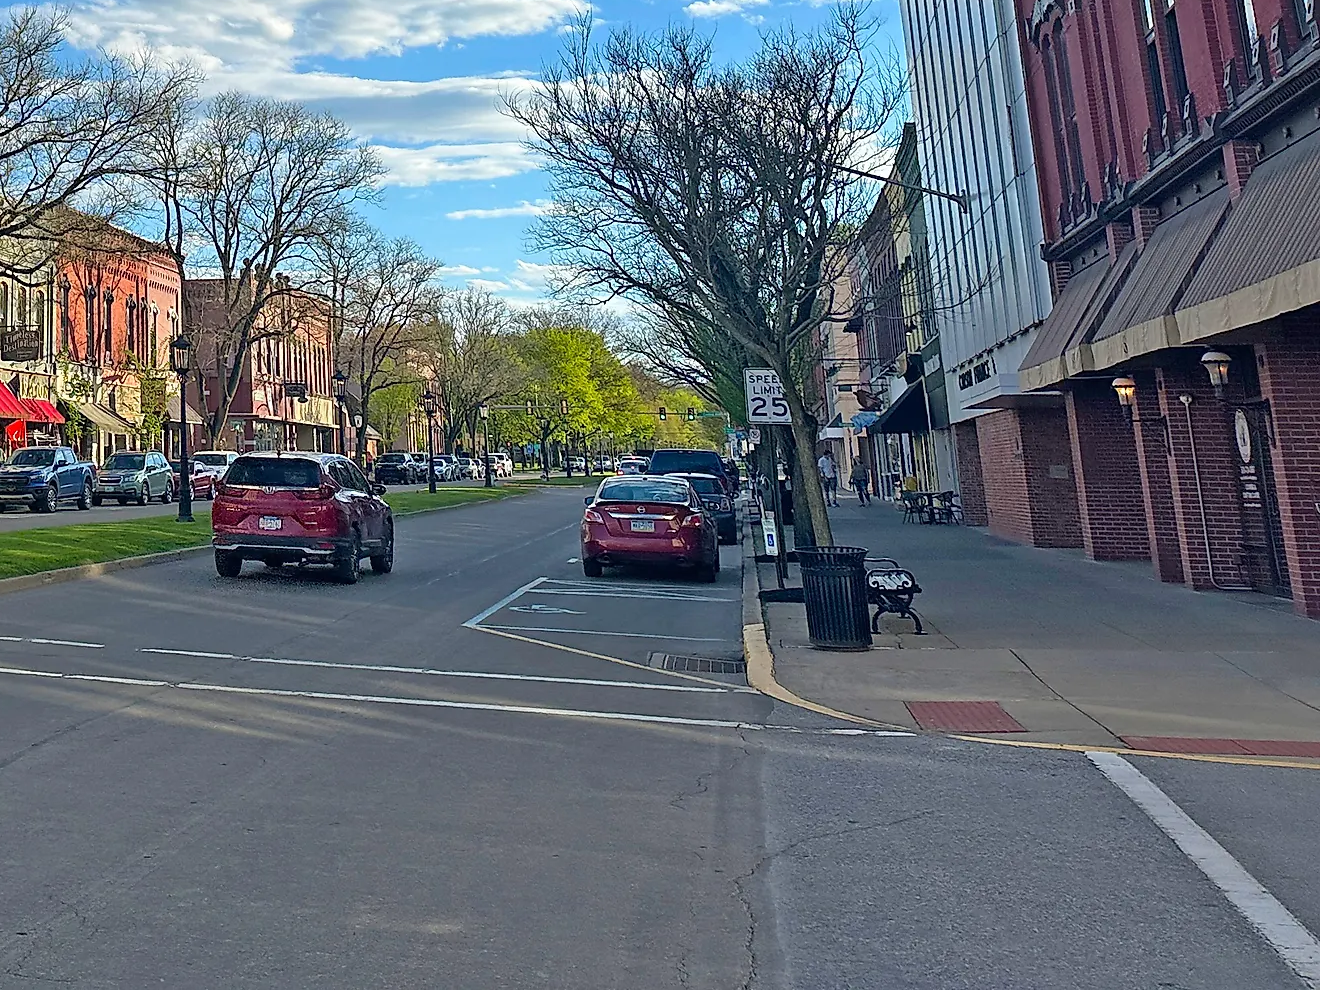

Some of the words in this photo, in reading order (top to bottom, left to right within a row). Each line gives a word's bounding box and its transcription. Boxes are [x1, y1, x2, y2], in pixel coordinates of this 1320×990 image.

[749, 375, 781, 384] SPEE
[753, 386, 782, 395] LIMIT
[750, 397, 788, 417] 25
